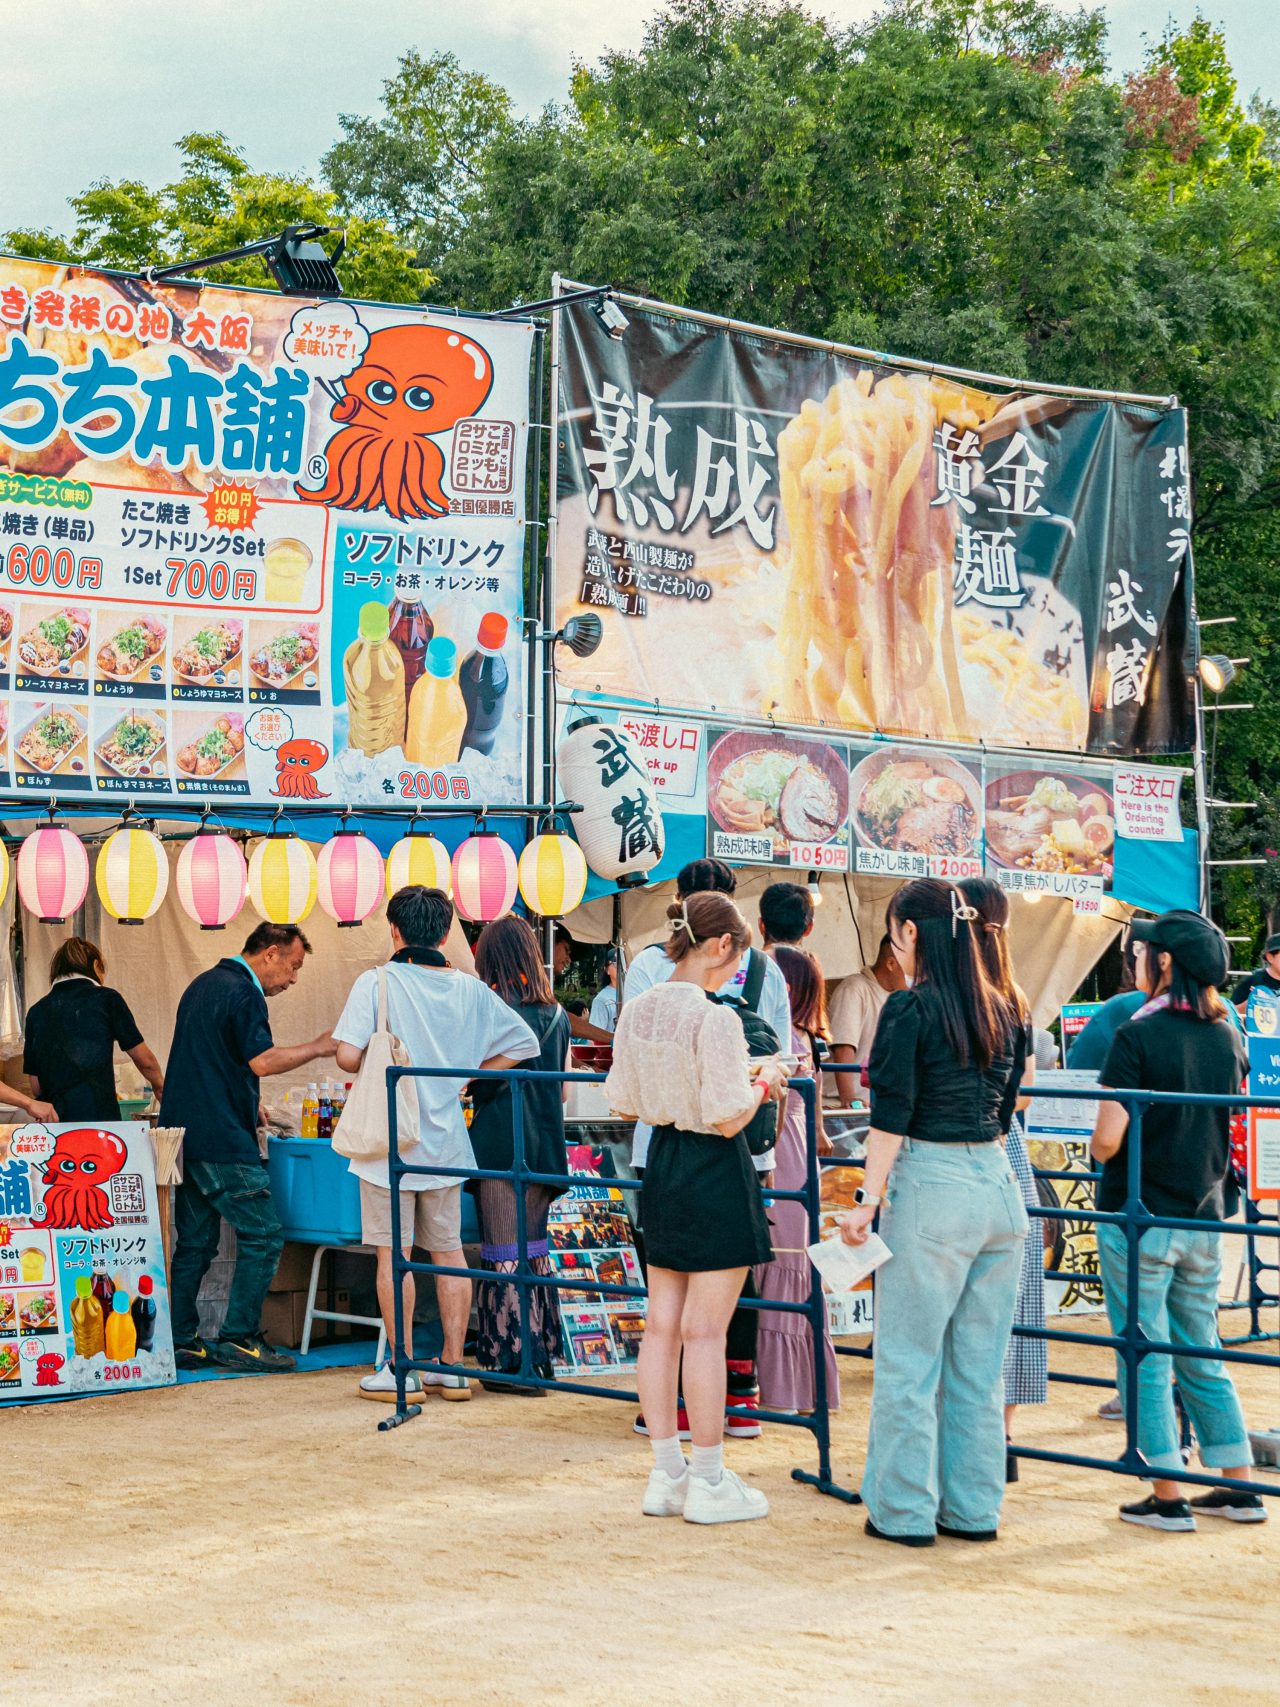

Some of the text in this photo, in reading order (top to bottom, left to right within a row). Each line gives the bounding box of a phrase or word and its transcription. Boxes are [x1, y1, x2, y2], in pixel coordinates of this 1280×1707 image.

[186, 311, 252, 350] 大阪
[301, 321, 353, 339] メッチャ
[582, 381, 776, 550] 熟成
[930, 422, 1051, 517] 黄金
[213, 489, 252, 507] 100円
[450, 499, 514, 515] 全国優勝店
[122, 500, 191, 526] たこ焼き
[120, 527, 266, 557] ソフトドリンクSet
[346, 532, 505, 568] ソフトドリンク
[7, 542, 104, 590] 600円
[954, 524, 1026, 608] 麺
[166, 558, 257, 601] 700円
[24, 679, 85, 691] ソースマヨネーズ
[104, 684, 134, 694] しょうゆ
[180, 688, 242, 700] しょうゆマヨネーズ
[260, 691, 277, 701] しお
[664, 762, 678, 773] up
[398, 770, 470, 799] 200円
[592, 727, 661, 863] 武蔵
[1116, 773, 1175, 799] ご注文口
[1121, 800, 1169, 814] Here is the
[1125, 814, 1164, 826] Ordering
[1129, 826, 1165, 836] counter
[716, 836, 772, 858] 熟成味噌
[859, 851, 982, 878] 焦がし味噌 1200円
[18, 1135, 47, 1143] メッチャ
[62, 1236, 147, 1256] ソフトドリンク
[104, 1365, 142, 1381] 200円
